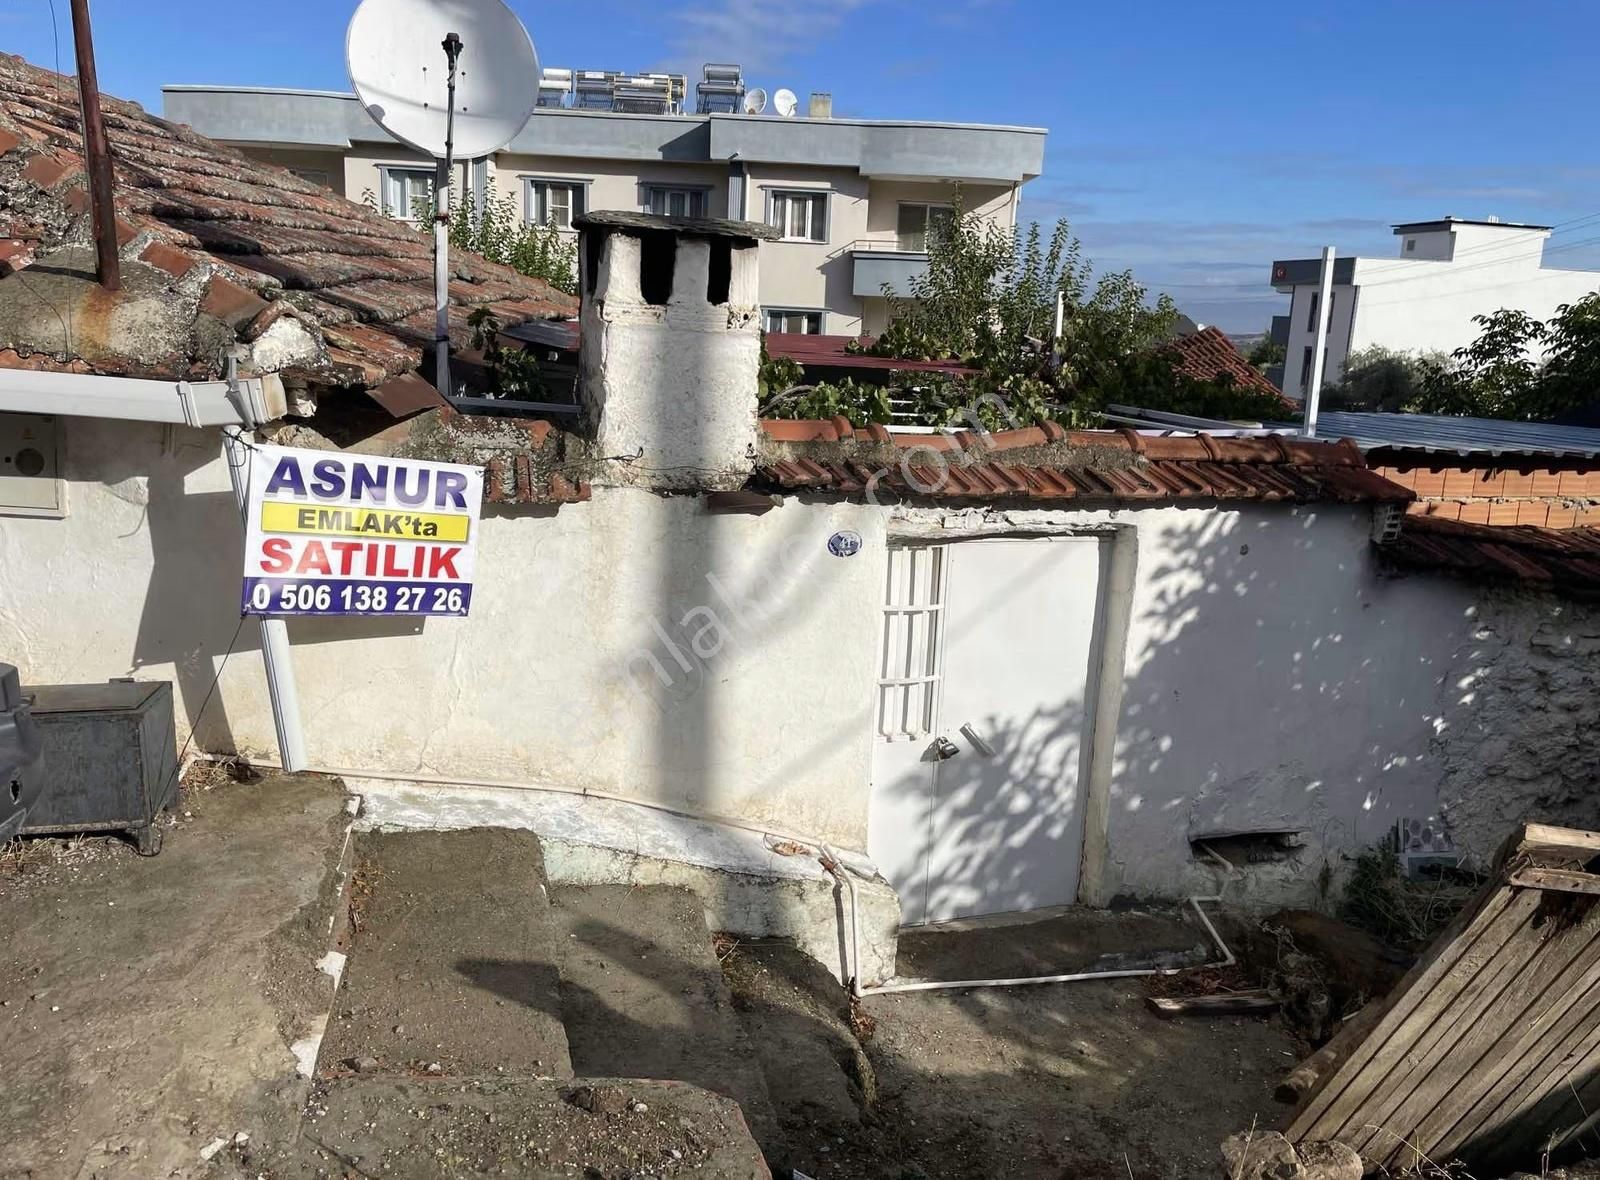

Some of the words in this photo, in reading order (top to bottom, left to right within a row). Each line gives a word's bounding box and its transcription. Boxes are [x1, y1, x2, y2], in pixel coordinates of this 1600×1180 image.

[264, 455, 468, 510] ASNUR
[297, 508, 438, 537] EMLAK’ta
[259, 538, 463, 579] SATILIK
[252, 583, 271, 610] 0
[280, 584, 331, 610] 506
[340, 585, 388, 611] 138
[395, 587, 426, 611] 27
[432, 587, 462, 612] 26
